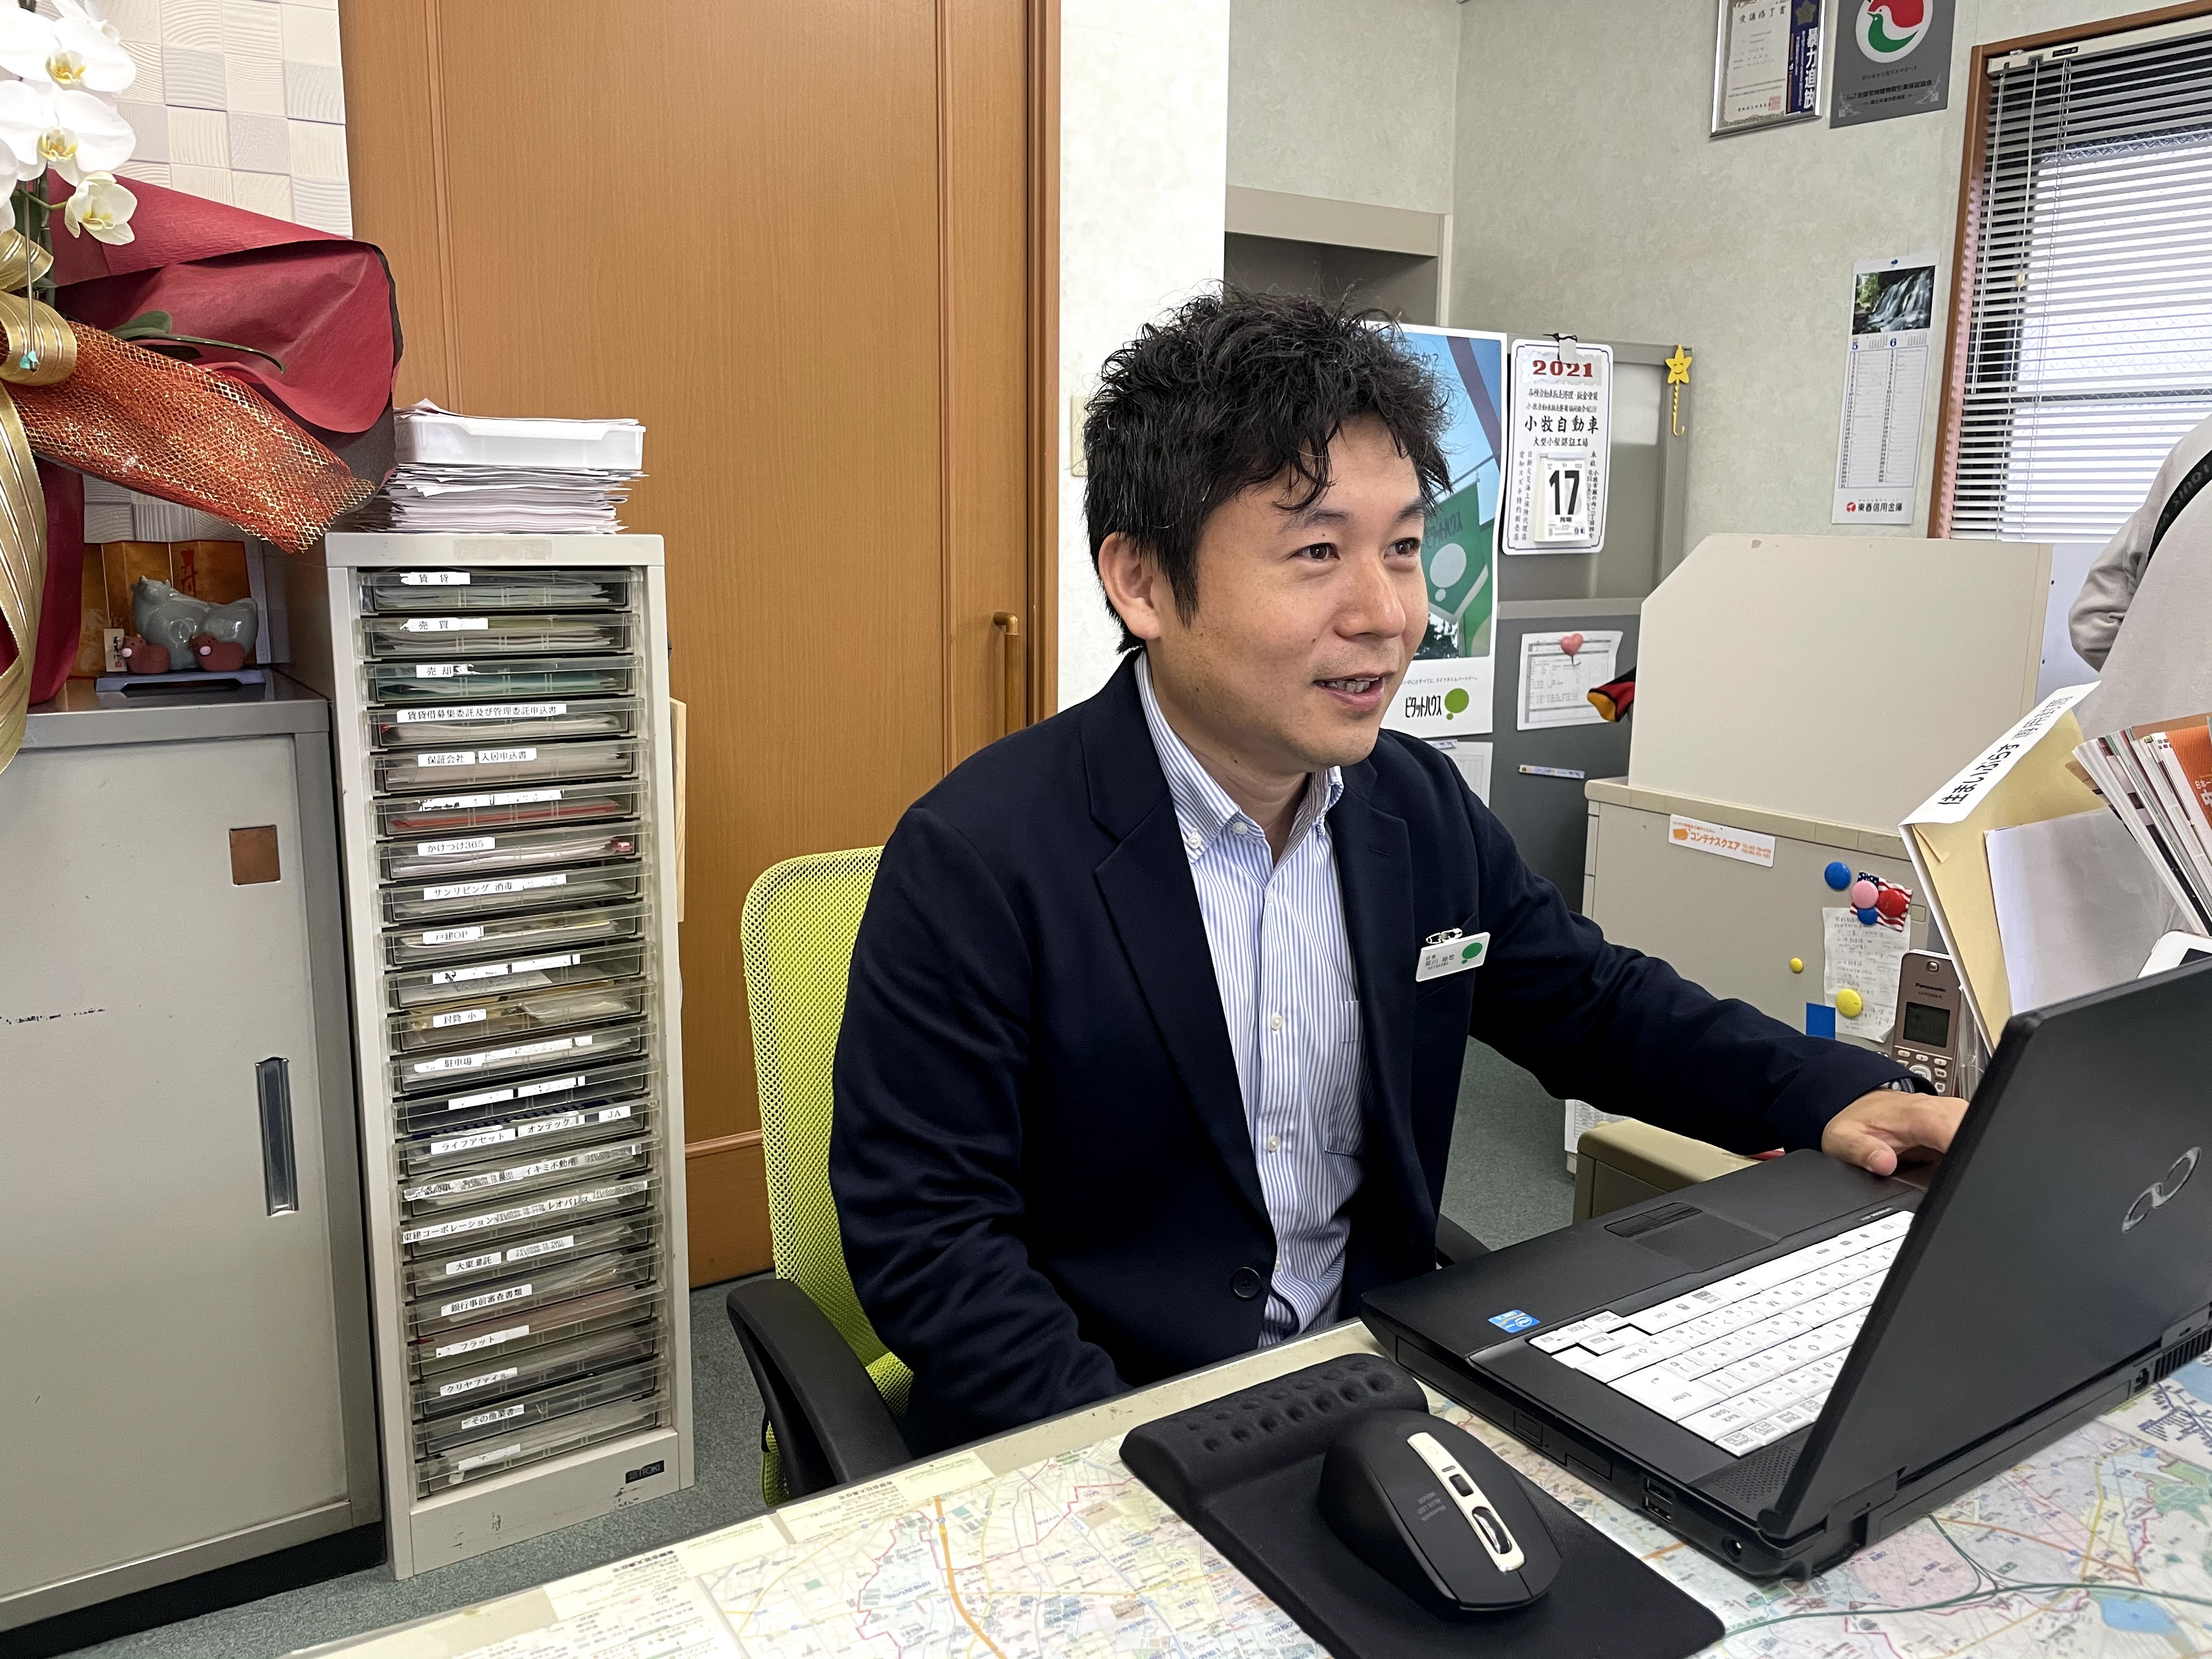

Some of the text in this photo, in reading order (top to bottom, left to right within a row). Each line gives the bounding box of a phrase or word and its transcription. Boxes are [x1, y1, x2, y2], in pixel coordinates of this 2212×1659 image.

[1852, 341, 1858, 350] 5
[1890, 338, 1897, 347] 6
[1532, 360, 1593, 377] 2021
[1525, 415, 1599, 434] 小牧自動車
[1549, 470, 1580, 515] 17
[1405, 695, 1442, 718] ピタットハウス
[427, 754, 465, 764] 保証会社
[1690, 831, 1741, 850] コンテナスクエア
[427, 840, 484, 853] かけつけ365
[435, 930, 468, 941] 戸建OP
[1915, 982, 1946, 993] Panasonic
[467, 1012, 476, 1020] 小
[607, 1109, 621, 1119] JA
[527, 1118, 570, 1133] オンテック
[442, 1132, 505, 1151] ライフアセット
[404, 1216, 494, 1242] 東建コーポレーション
[1671, 1392, 1692, 1402] Enter
[1708, 1408, 1731, 1419] Space
[1723, 1413, 1740, 1423] Back
